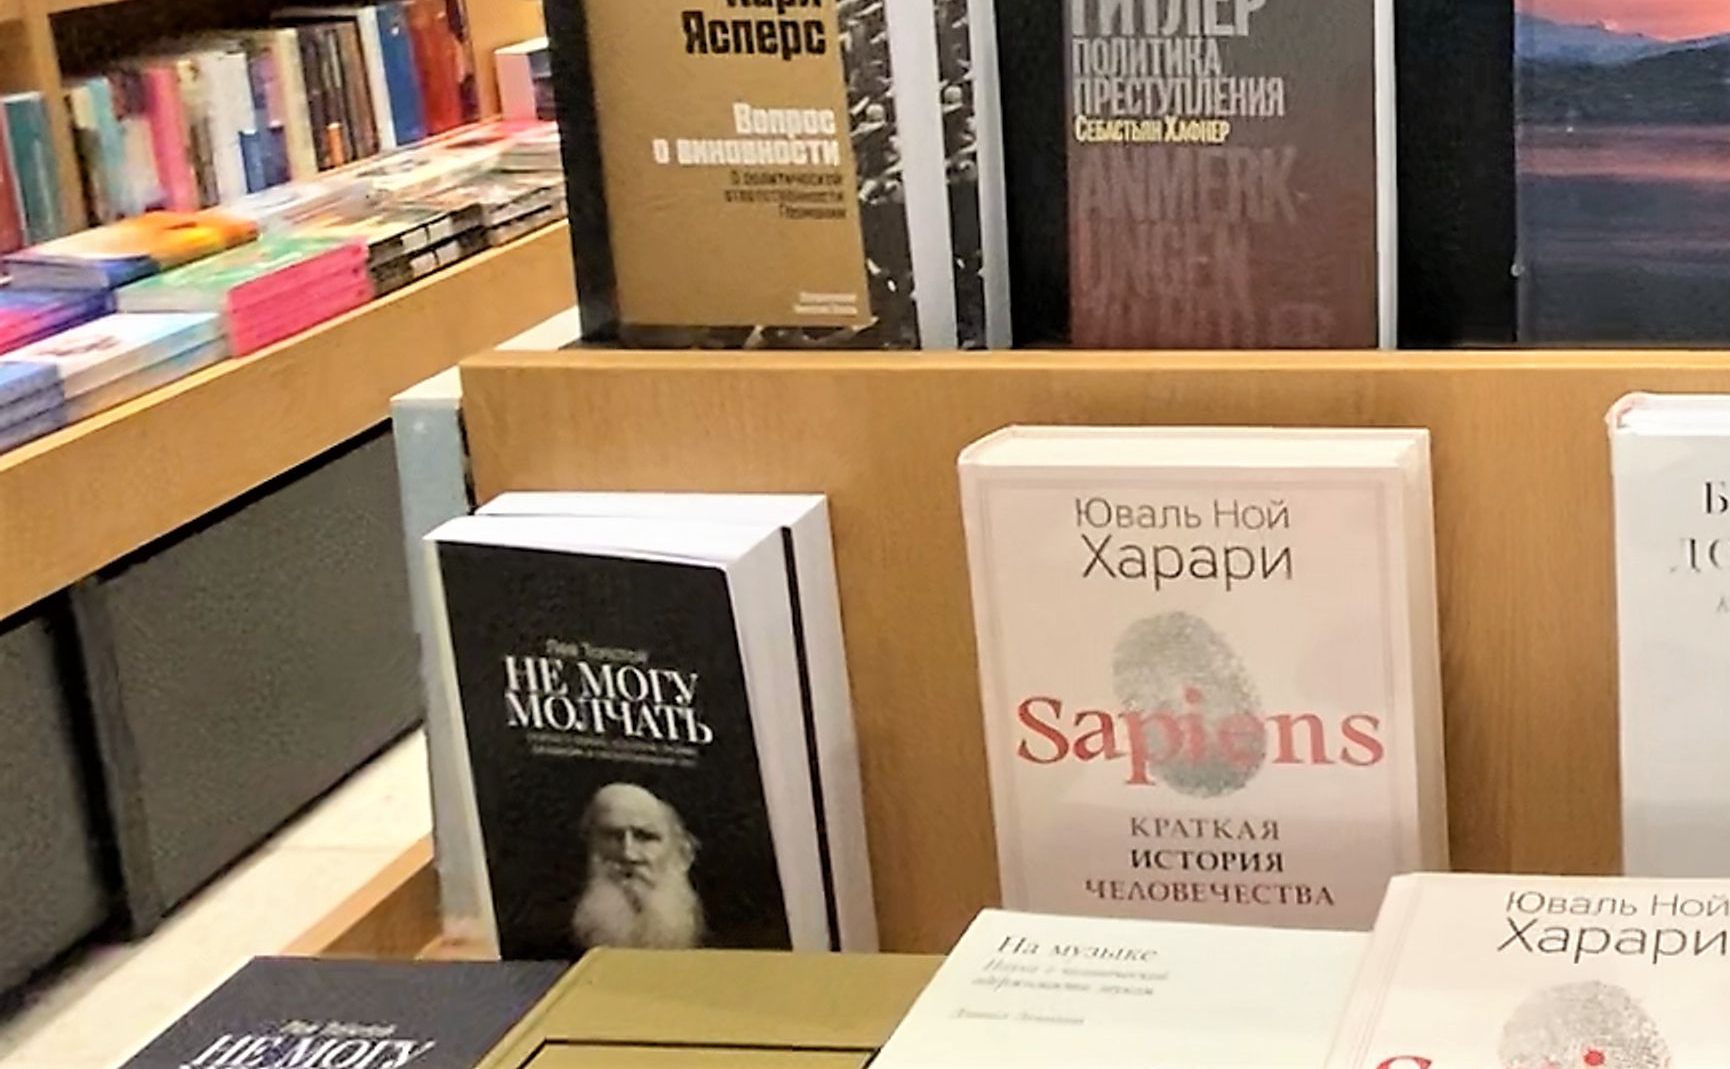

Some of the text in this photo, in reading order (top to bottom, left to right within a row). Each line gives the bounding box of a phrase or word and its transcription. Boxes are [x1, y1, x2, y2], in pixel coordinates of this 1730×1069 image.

[680, 10, 828, 62] Ясперс
[1071, 37, 1222, 77] ПОЛИТИКА
[1072, 75, 1286, 116] ПРЕСТУПЛЕНИЯ
[732, 102, 836, 139] Вопрос
[675, 138, 840, 167] виновности
[1075, 497, 1291, 531] Юваль Ной
[1081, 533, 1293, 592] Харари
[505, 655, 699, 705] НЕ МОГУ
[505, 691, 714, 744] МОЛЧАТЬ
[1016, 686, 1385, 786] Sapiens
[1129, 816, 1281, 841] КРАТКАЯ
[1129, 848, 1285, 873] ИСТОРИЯ
[1084, 877, 1337, 907] ЧЕЛОВЕЧЕСТВА
[1506, 890, 1730, 918] Юваль Ной
[997, 934, 1160, 963] На музыке
[1496, 916, 1729, 965] Харари
